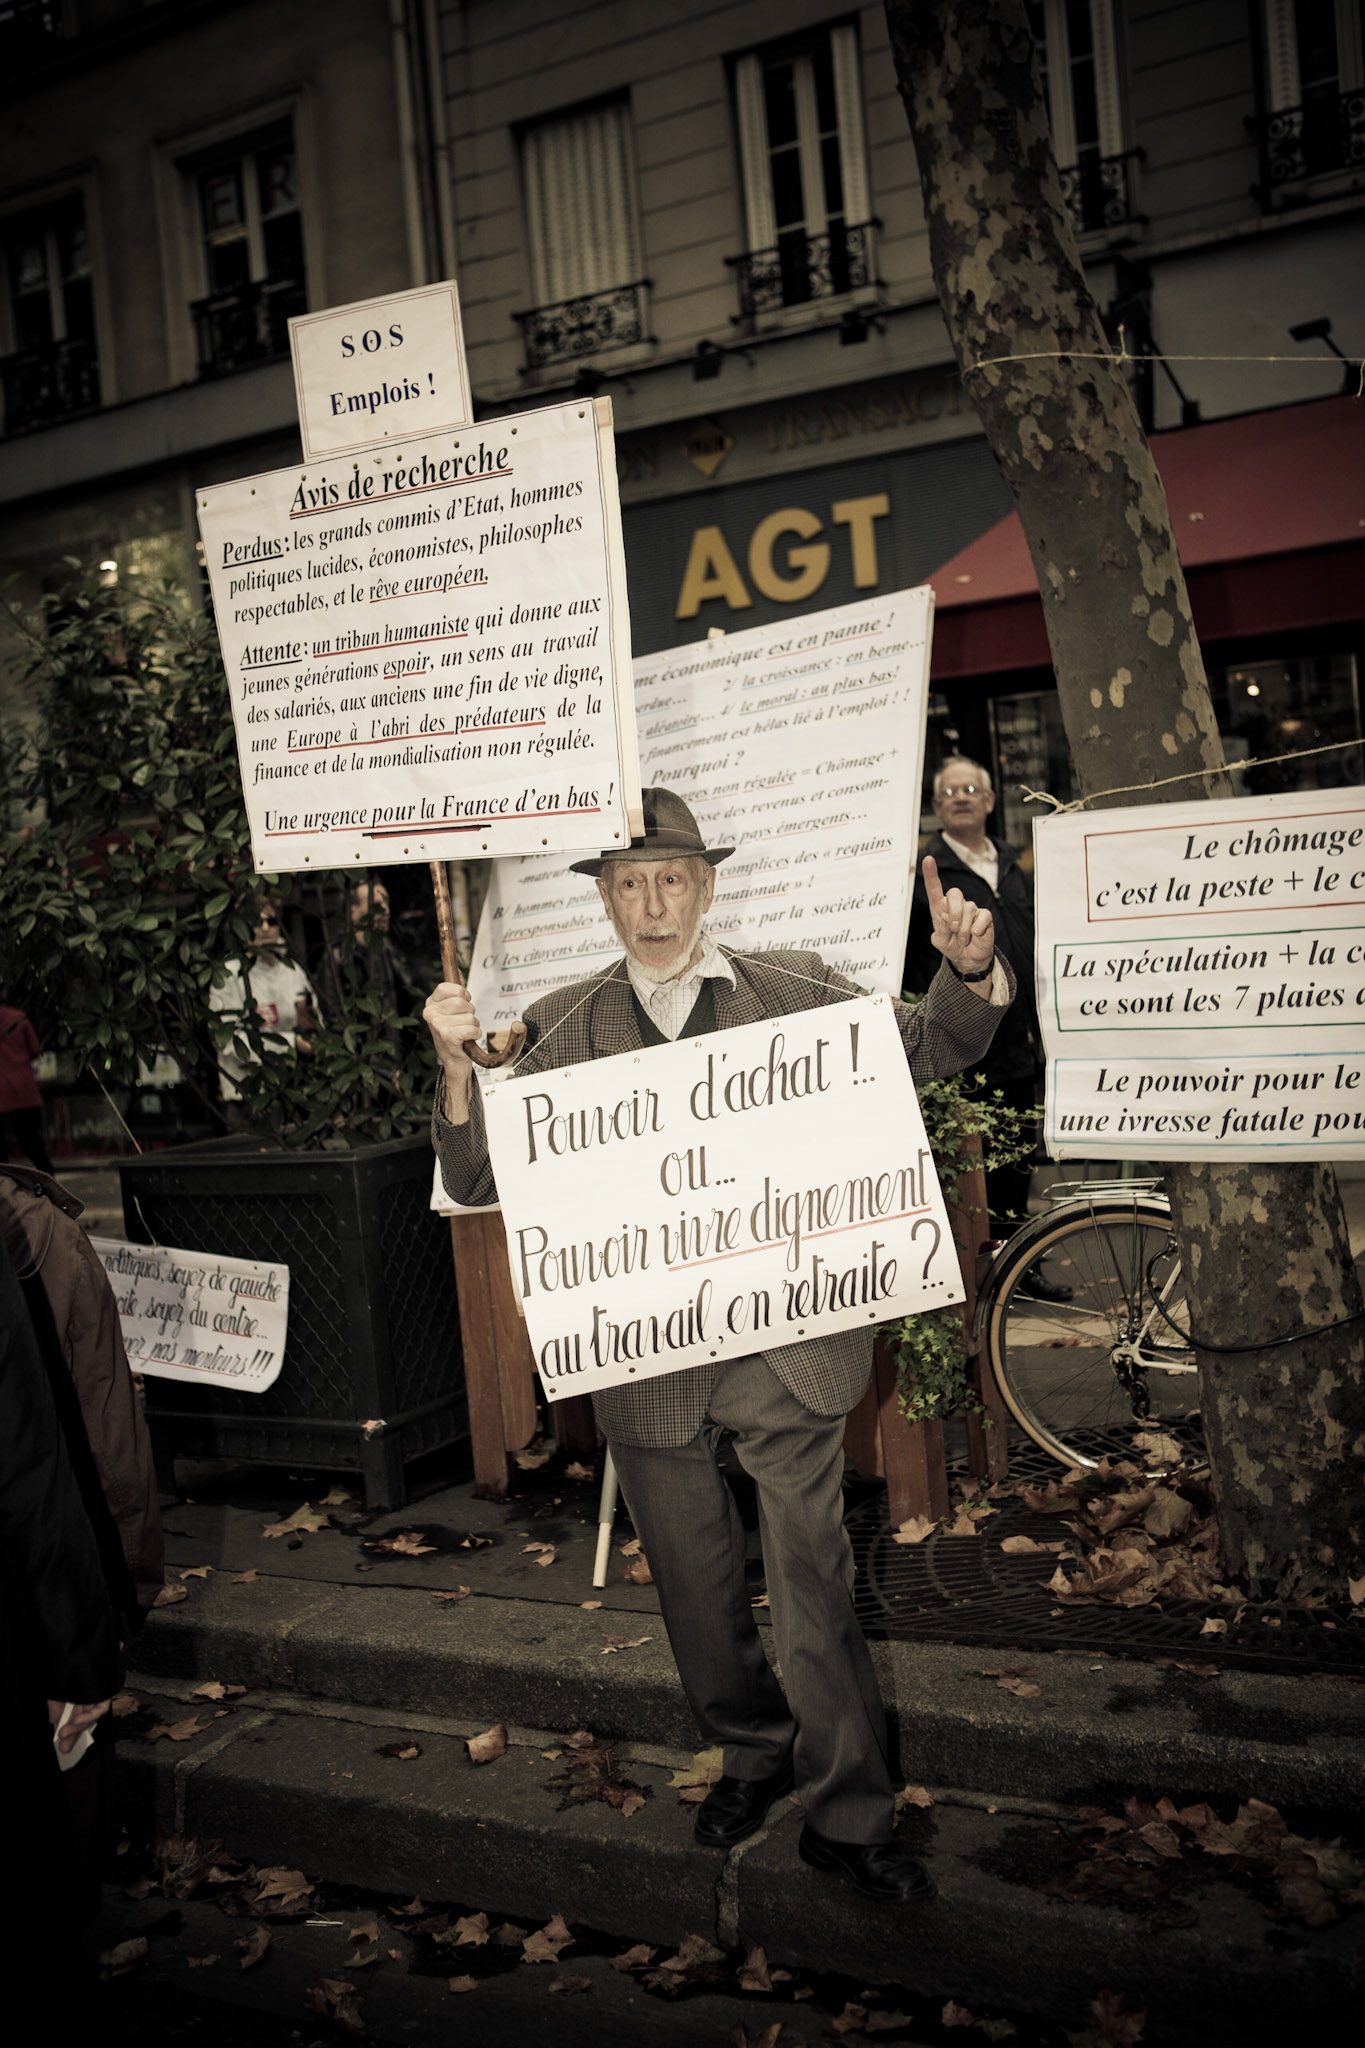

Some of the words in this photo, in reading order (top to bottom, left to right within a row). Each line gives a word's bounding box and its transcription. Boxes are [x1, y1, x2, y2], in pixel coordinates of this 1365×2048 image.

[330, 378, 420, 416] Emplois
[428, 372, 436, 395] !
[290, 480, 338, 513] Avis
[348, 473, 374, 500] de
[382, 447, 510, 493] recherche
[294, 530, 313, 549] les
[319, 517, 371, 550] grands
[377, 504, 440, 533] commis
[446, 494, 503, 520] d'Etat,
[510, 481, 582, 508] hommes
[230, 568, 301, 599] politiques
[307, 554, 362, 579] lucides,
[369, 536, 472, 567] économistes,
[479, 513, 582, 554] philosophes
[674, 493, 891, 620] AGT
[235, 592, 328, 625] respectables,
[333, 589, 345, 606] et
[351, 583, 363, 602] le
[369, 578, 399, 603] rêve
[404, 564, 488, 594] européen.
[313, 636, 331, 655] un
[335, 629, 380, 654] tribun
[384, 615, 469, 646] humaniste
[475, 606, 502, 634] qui
[510, 603, 561, 624] donne
[568, 597, 601, 616] aux
[768, 638, 793, 656] est
[797, 635, 818, 649] en
[821, 620, 882, 647] panne
[241, 677, 289, 700] jeunes
[294, 661, 378, 692] générations
[383, 651, 433, 679] espoir,
[441, 651, 461, 667] un
[468, 646, 504, 663] sens
[511, 642, 532, 657] au
[543, 626, 598, 653] travail
[742, 675, 756, 688] la
[759, 659, 832, 683] croissance
[846, 652, 863, 664] en
[247, 705, 269, 723] des
[274, 696, 334, 720] salariés,
[340, 696, 365, 711] aux
[371, 685, 425, 707] anciens
[433, 683, 463, 699] une
[465, 674, 491, 701] fin
[498, 671, 518, 691] de
[524, 667, 547, 688] vie
[553, 663, 602, 688] digne,
[741, 702, 754, 713] le
[757, 688, 799, 708] moral
[811, 684, 829, 696] au
[832, 677, 864, 695] plus
[252, 737, 276, 752] une
[287, 729, 341, 752] Europe
[350, 722, 357, 741] à
[371, 715, 408, 741] l'abri
[419, 713, 445, 733] des
[455, 706, 545, 734] prédateurs
[557, 697, 575, 717] de
[586, 694, 601, 714] la
[645, 732, 728, 764] financement
[731, 727, 750, 740] est
[753, 719, 789, 735] hélas
[828, 694, 889, 720] l'emploi
[252, 762, 308, 785] finance
[314, 759, 326, 774] et
[332, 754, 346, 772] de
[351, 752, 363, 770] la
[369, 741, 481, 768] mondialisation
[488, 741, 520, 756] non
[527, 728, 593, 757] régulée.
[651, 753, 730, 785] Pourquoi
[712, 782, 740, 796] non
[743, 769, 797, 789] régulée
[815, 753, 885, 776] Chômage
[265, 811, 298, 831] Une
[304, 809, 367, 831] urgence
[371, 805, 416, 829] pour
[421, 797, 435, 819] la
[442, 795, 509, 816] France
[515, 788, 559, 811] d'en
[567, 785, 598, 807] bas
[607, 782, 613, 805] !
[724, 805, 746, 819] des
[751, 795, 806, 813] revenus
[810, 790, 824, 802] et
[827, 779, 889, 798] consom-
[717, 833, 736, 846] les
[739, 827, 771, 845] pays
[719, 857, 790, 876] complices
[795, 849, 818, 865] des
[835, 837, 893, 858] requins
[1184, 835, 1218, 859] Le
[1228, 827, 1363, 856] chômage
[513, 899, 564, 916] hommes
[1096, 882, 1158, 908] c'est
[1165, 877, 1190, 901] la
[1198, 874, 1273, 907] peste
[1313, 865, 1339, 891] le
[504, 916, 593, 940] irresponsables
[758, 910, 785, 928] par
[789, 905, 804, 919] la
[813, 898, 865, 917] société
[869, 892, 887, 907] de
[501, 953, 520, 967] les
[523, 944, 573, 965] citoyens
[1061, 954, 1096, 978] La
[1104, 945, 1266, 982] spéculation
[1308, 939, 1335, 965] la
[1080, 999, 1107, 1015] ce
[1117, 992, 1173, 1013] sont
[1183, 987, 1220, 1012] les
[1235, 985, 1249, 1009] 7
[1256, 982, 1344, 1016] plaies
[523, 1089, 664, 1165] Pouvoir
[690, 1033, 831, 1122] d'achat
[1096, 1068, 1128, 1091] Le
[1135, 1067, 1244, 1099] pouvoir
[1251, 1072, 1324, 1098] pour
[1334, 1063, 1360, 1089] le
[1060, 1111, 1110, 1133] une
[1117, 1107, 1210, 1132] ivresse
[1215, 1106, 1303, 1139] fatale
[515, 1223, 650, 1298] Pouvoir
[659, 1204, 741, 1266] vivre
[750, 1148, 931, 1272] dignement
[209, 1266, 225, 1291] de
[229, 1271, 281, 1309] gauche
[189, 1301, 208, 1328] du
[540, 1330, 583, 1380] au
[726, 1290, 772, 1334] en
[782, 1241, 899, 1321] retraite
